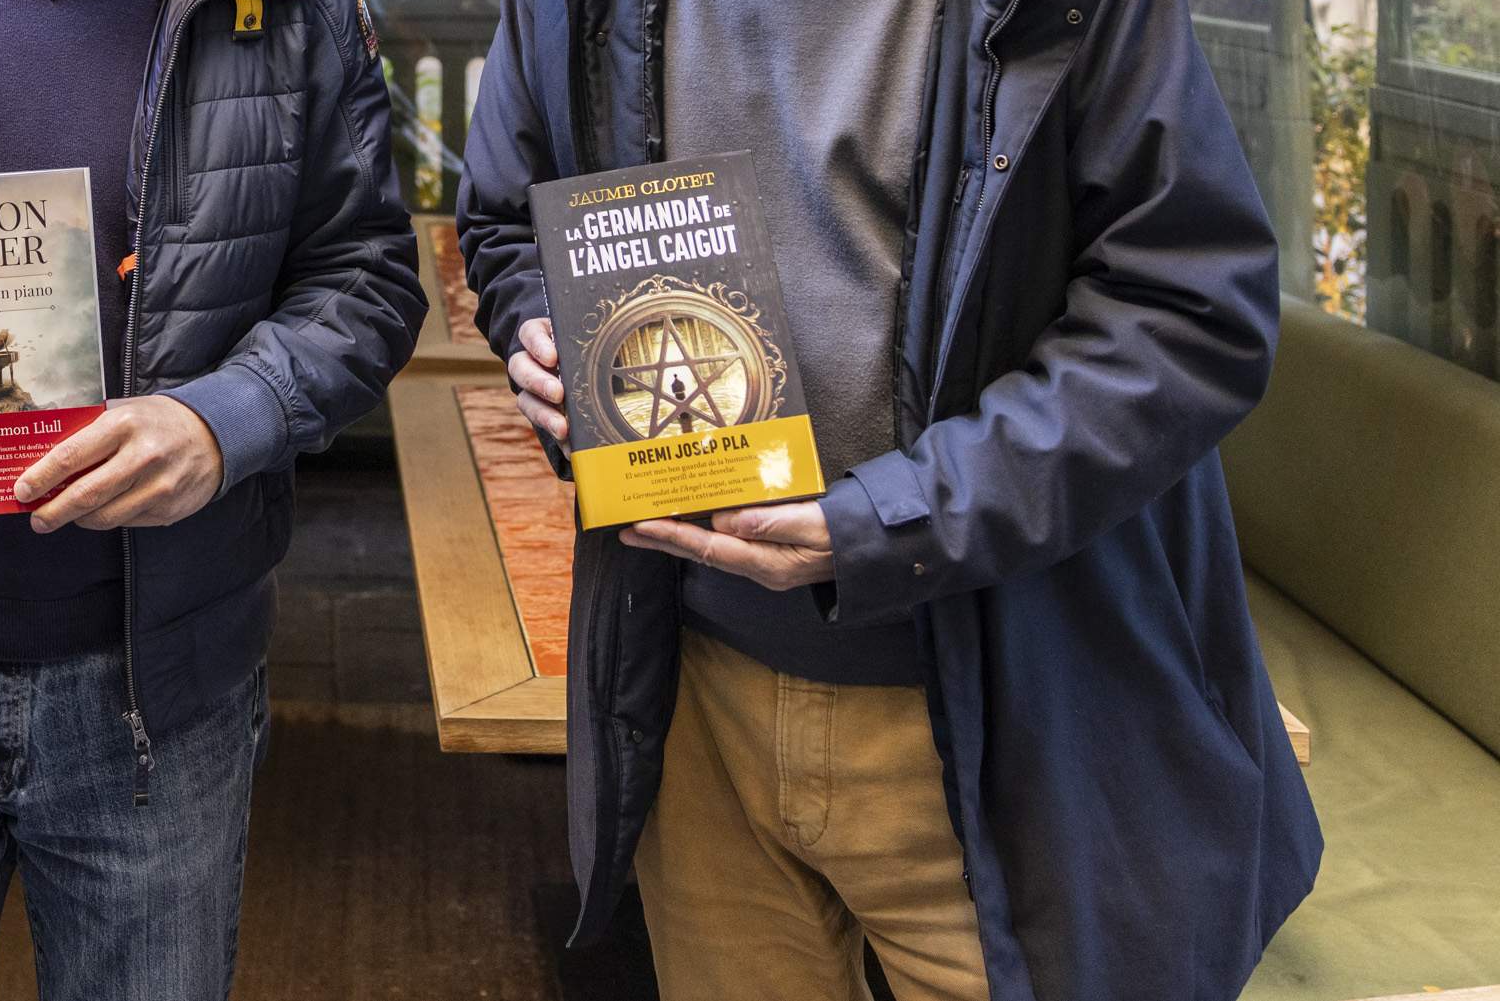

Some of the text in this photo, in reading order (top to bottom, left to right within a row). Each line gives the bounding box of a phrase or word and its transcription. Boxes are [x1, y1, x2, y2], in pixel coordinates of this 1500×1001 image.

[569, 172, 716, 208] JAUME CLOTET
[565, 195, 732, 242] LA GERMANDAT DE
[569, 224, 738, 277] L'ÀNGEL CAIGUT
[14, 284, 53, 301] piano
[33, 419, 62, 434] Llull
[628, 434, 750, 466] PREMI JOSEP PLA
